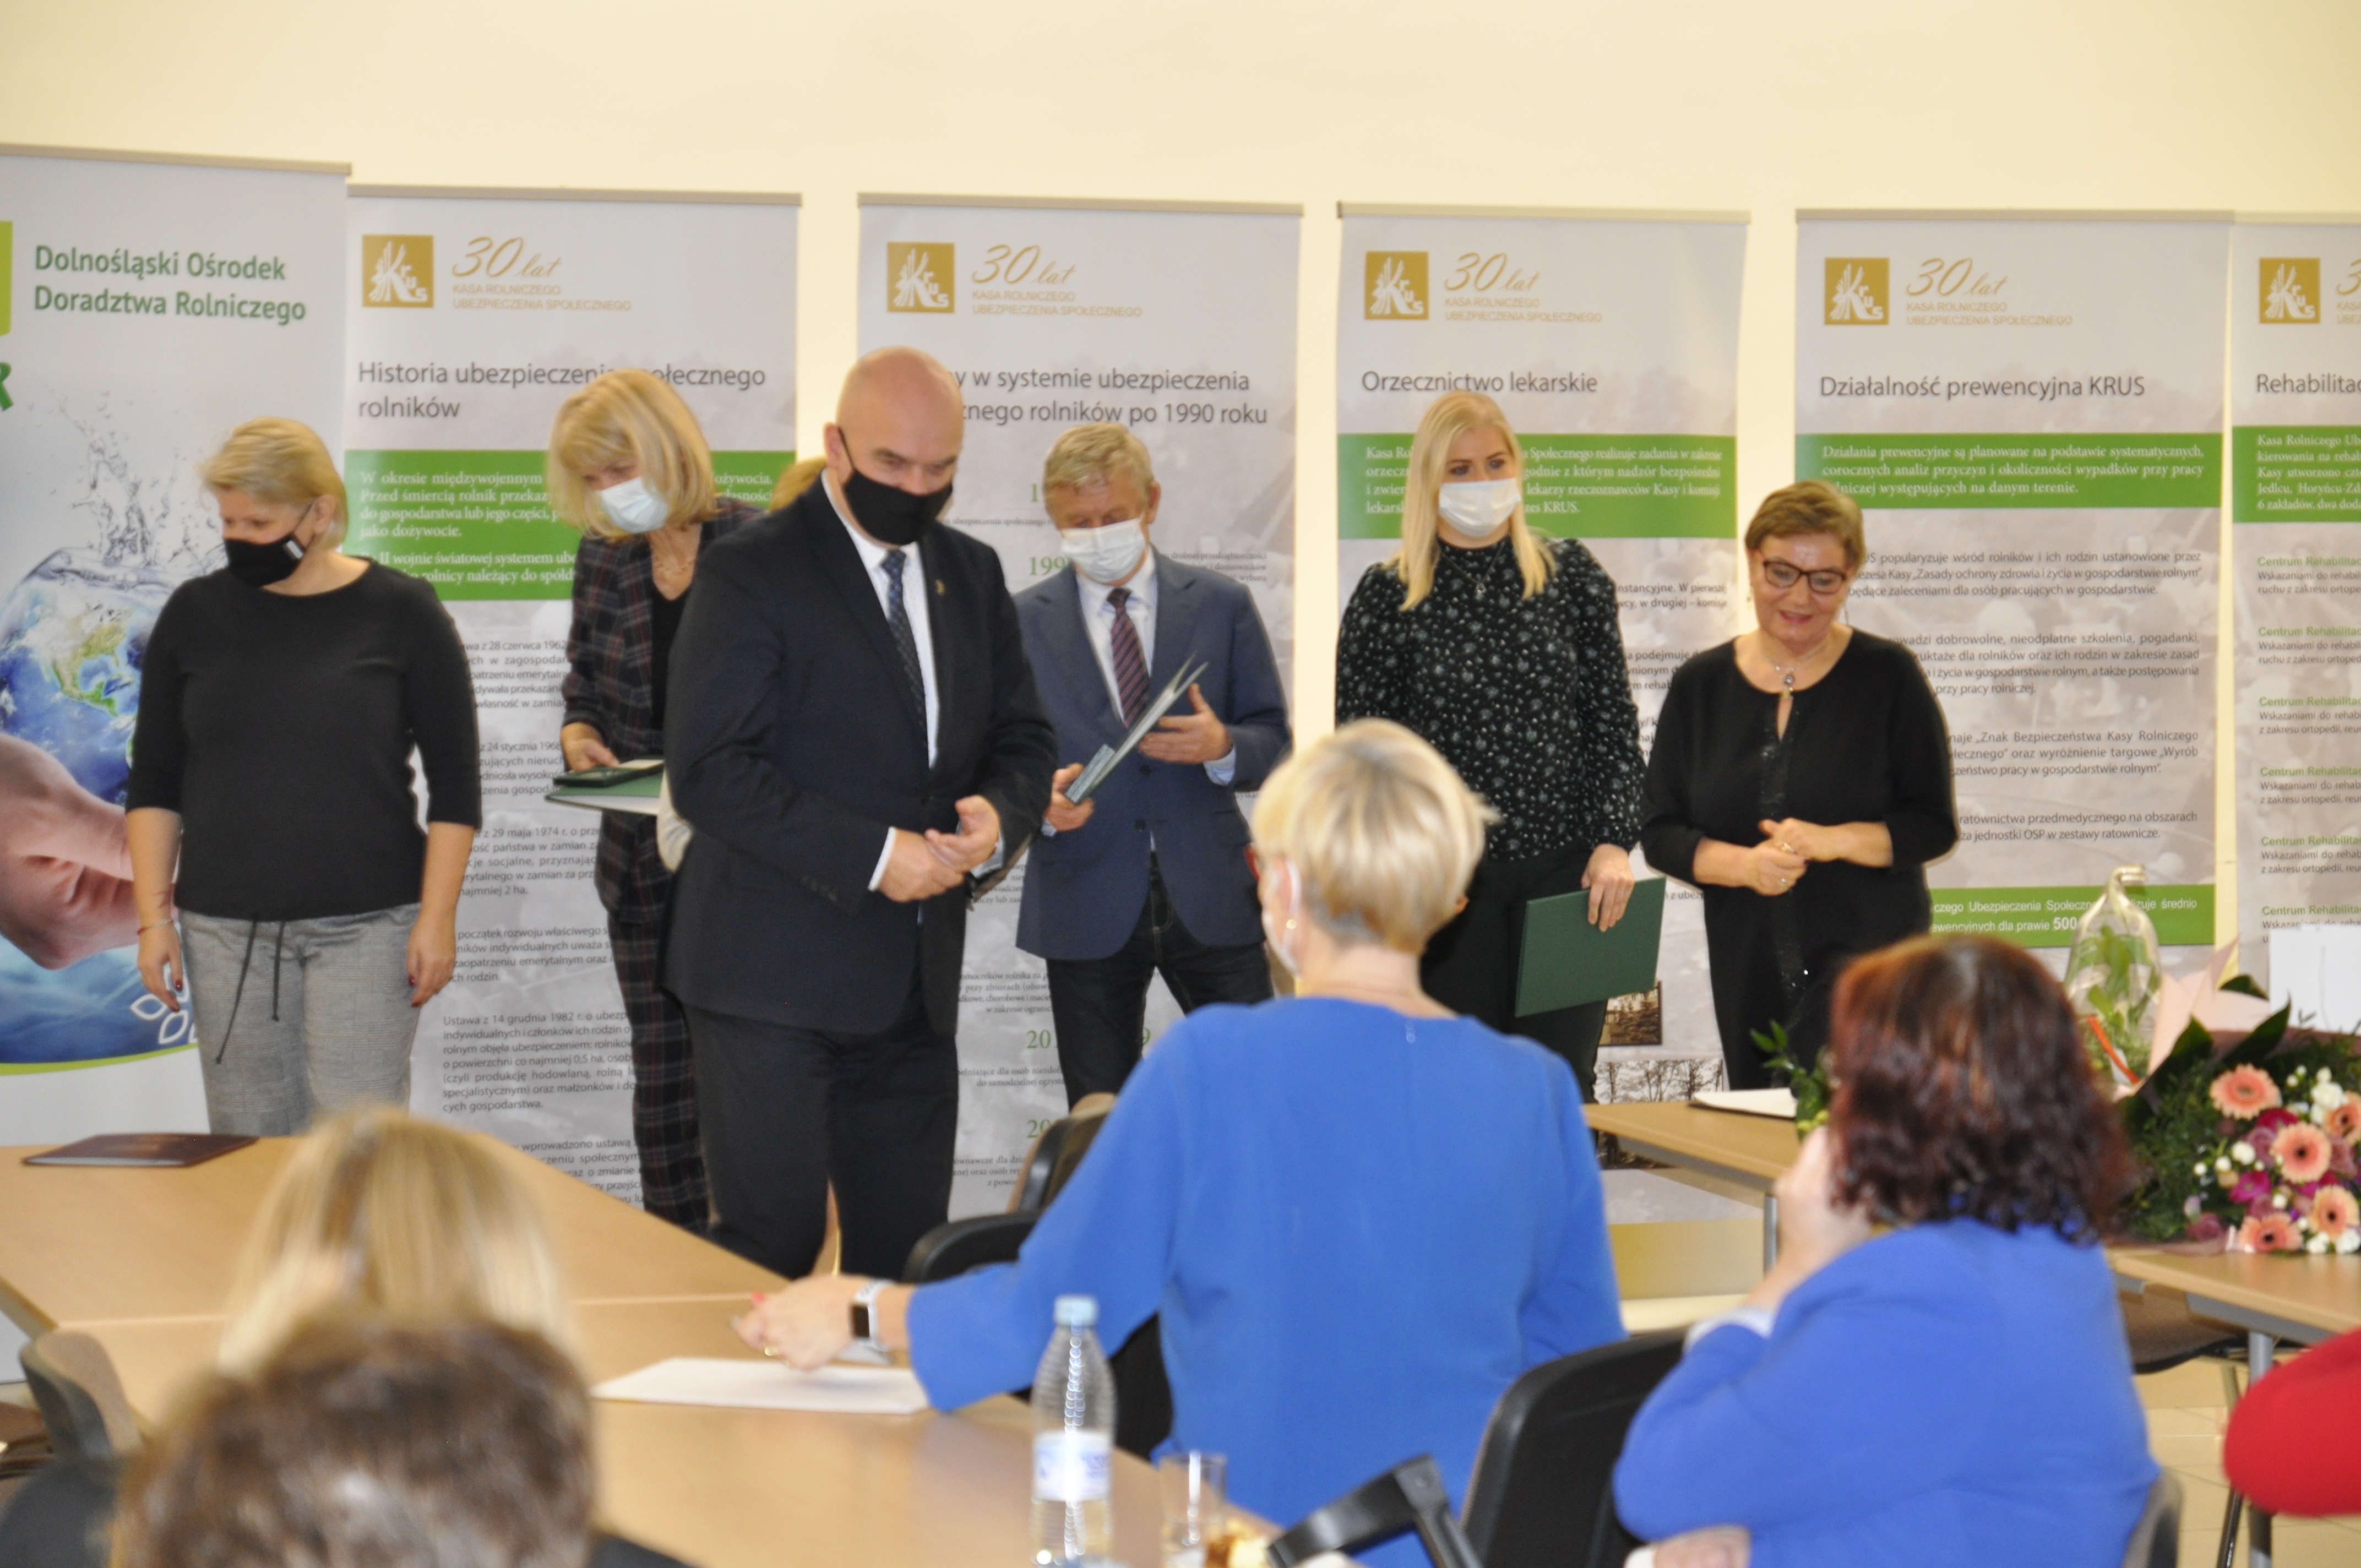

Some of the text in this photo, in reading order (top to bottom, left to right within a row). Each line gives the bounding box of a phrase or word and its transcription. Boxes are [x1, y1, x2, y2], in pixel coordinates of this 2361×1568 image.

[36, 245, 285, 280] Dolnośląski Ośrodek
[452, 236, 523, 278] 30
[972, 244, 1040, 284] 30
[1445, 252, 1507, 291] 30
[1907, 258, 1973, 296] 30
[453, 284, 561, 295] KASA ROLNICZEGO
[972, 290, 1075, 302] KASA ROLNICZEGO
[35, 285, 306, 326] Doradztwa Rolniczego
[453, 298, 632, 311] UBEZPIECZENIA SPOŁECZNEGO
[973, 304, 1143, 317] UBEZPIECZENIA SPOŁECZNEGO
[1445, 297, 1540, 308] KASA ROLNICZEGO
[1907, 302, 2008, 312] KASA ROLNICZEGO
[1445, 311, 1602, 322] UBEZPIECZENIA SPOŁECZNEGO
[1907, 315, 2073, 325] UBEZPIECZENIA SPOŁECZNEGO
[360, 362, 766, 393] Historia ubezpieczeni ołecznego
[972, 372, 991, 386] w
[998, 368, 1092, 393] systemie
[1098, 368, 1249, 394] ubezpieczenia
[1362, 371, 1597, 393] Orzecznictwo lekarskie
[2257, 373, 2361, 393] Rehabilita
[1821, 376, 2145, 401] Działalność prewencyjna KRUS
[359, 396, 460, 418] rolników
[1030, 400, 1122, 424] rolników
[1129, 407, 1157, 427] po
[1166, 404, 1214, 423] 1990
[1221, 403, 1267, 424] roku
[1823, 445, 2204, 460] Działania prewencyjne są planowane na podstawie systematycznych,
[1821, 462, 2203, 478] corocznych analiz przyczyn i okoliczności wypadków przy pracy
[361, 471, 542, 487] W okresie międzywojennym
[1880, 481, 2078, 497] występujących na danym terenie.
[1544, 502, 1579, 513] KRUS.
[361, 524, 461, 540] jako dożywocie.
[1969, 901, 2042, 914] Ubezpieczenia
[1998, 917, 2078, 933] dla prawie 500
